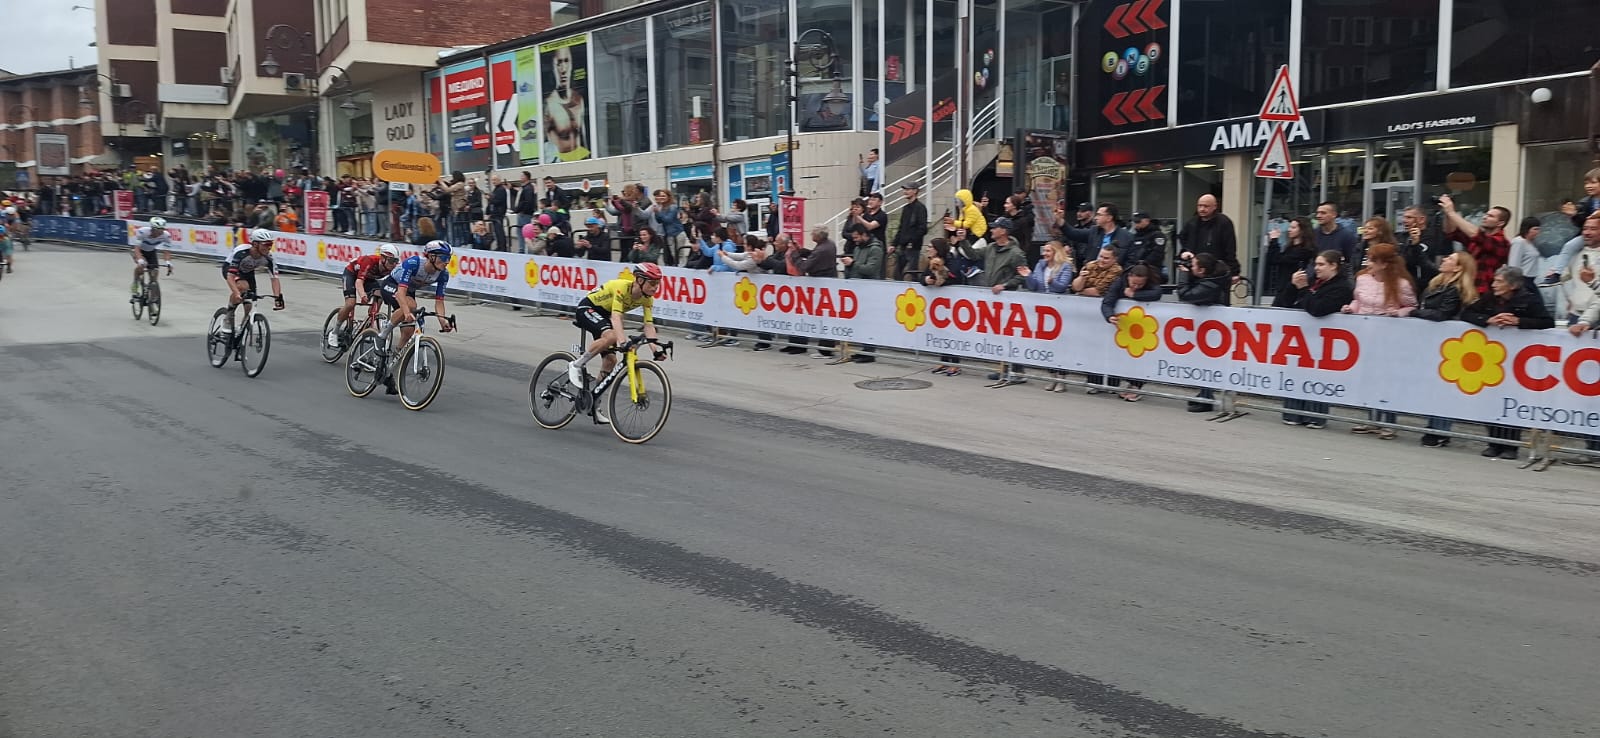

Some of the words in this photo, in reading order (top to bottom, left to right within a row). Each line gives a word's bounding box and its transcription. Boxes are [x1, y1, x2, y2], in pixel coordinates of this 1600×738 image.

[384, 102, 414, 120] LADY
[1388, 120, 1424, 132] LADY'S
[1424, 116, 1476, 129] FASHION
[386, 124, 415, 142] GOLD
[1210, 116, 1311, 151] AMAA
[276, 237, 307, 256] CONAD
[460, 256, 508, 281] CONAD
[540, 264, 598, 291] CONAD
[653, 276, 706, 304] NAD
[760, 284, 858, 319] CONAD
[757, 316, 792, 333] Persone
[794, 320, 818, 334] oltre
[820, 322, 828, 336] le
[831, 326, 854, 338] cose
[930, 297, 1062, 340] CONAD
[926, 332, 972, 352] Persone
[975, 338, 1006, 357] oltre
[1008, 342, 1021, 358] le
[1024, 346, 1055, 362] cose
[1164, 316, 1360, 372] CONAD
[1158, 360, 1223, 384] Persone
[1229, 366, 1271, 389] oltre
[1279, 370, 1295, 392] le
[1302, 378, 1346, 398] cose
[1502, 397, 1600, 428] Persone
